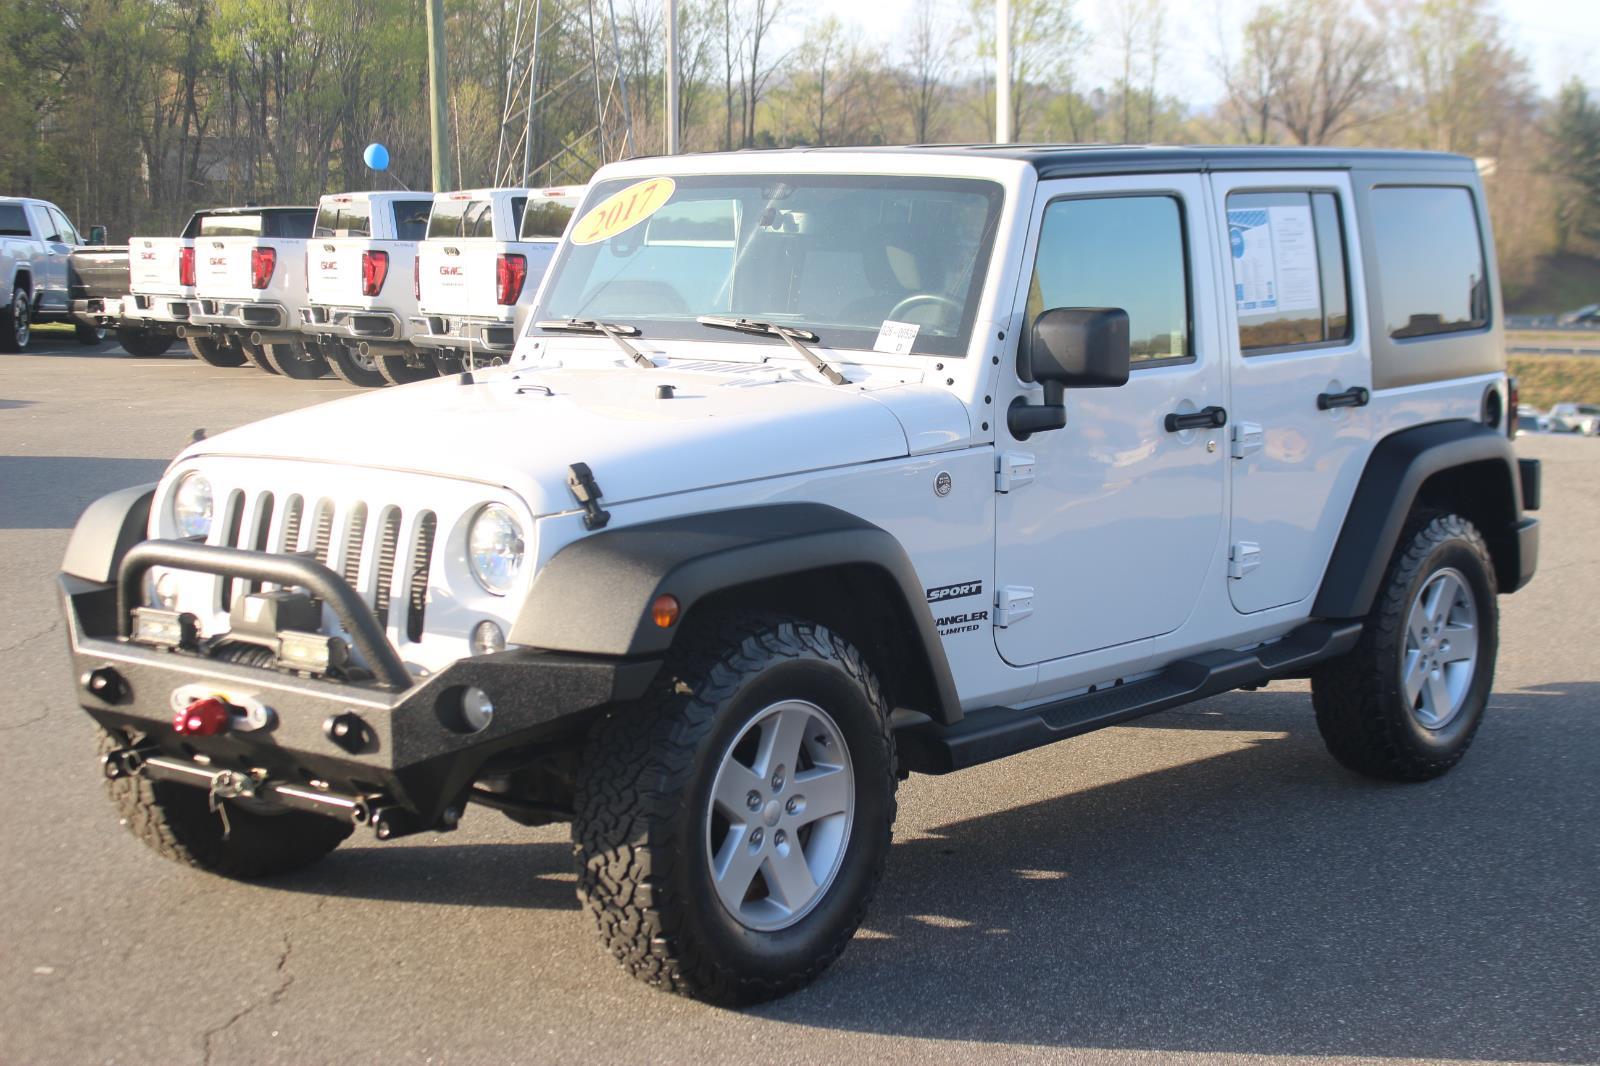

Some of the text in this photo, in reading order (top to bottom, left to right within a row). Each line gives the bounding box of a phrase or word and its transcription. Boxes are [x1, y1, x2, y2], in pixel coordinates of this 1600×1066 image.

[585, 183, 659, 240] 2017
[320, 260, 338, 270] GMC
[439, 265, 464, 276] GMC
[929, 583, 980, 599] SPORT
[935, 610, 989, 627] ANGLER
[938, 624, 980, 636] LIMITED
